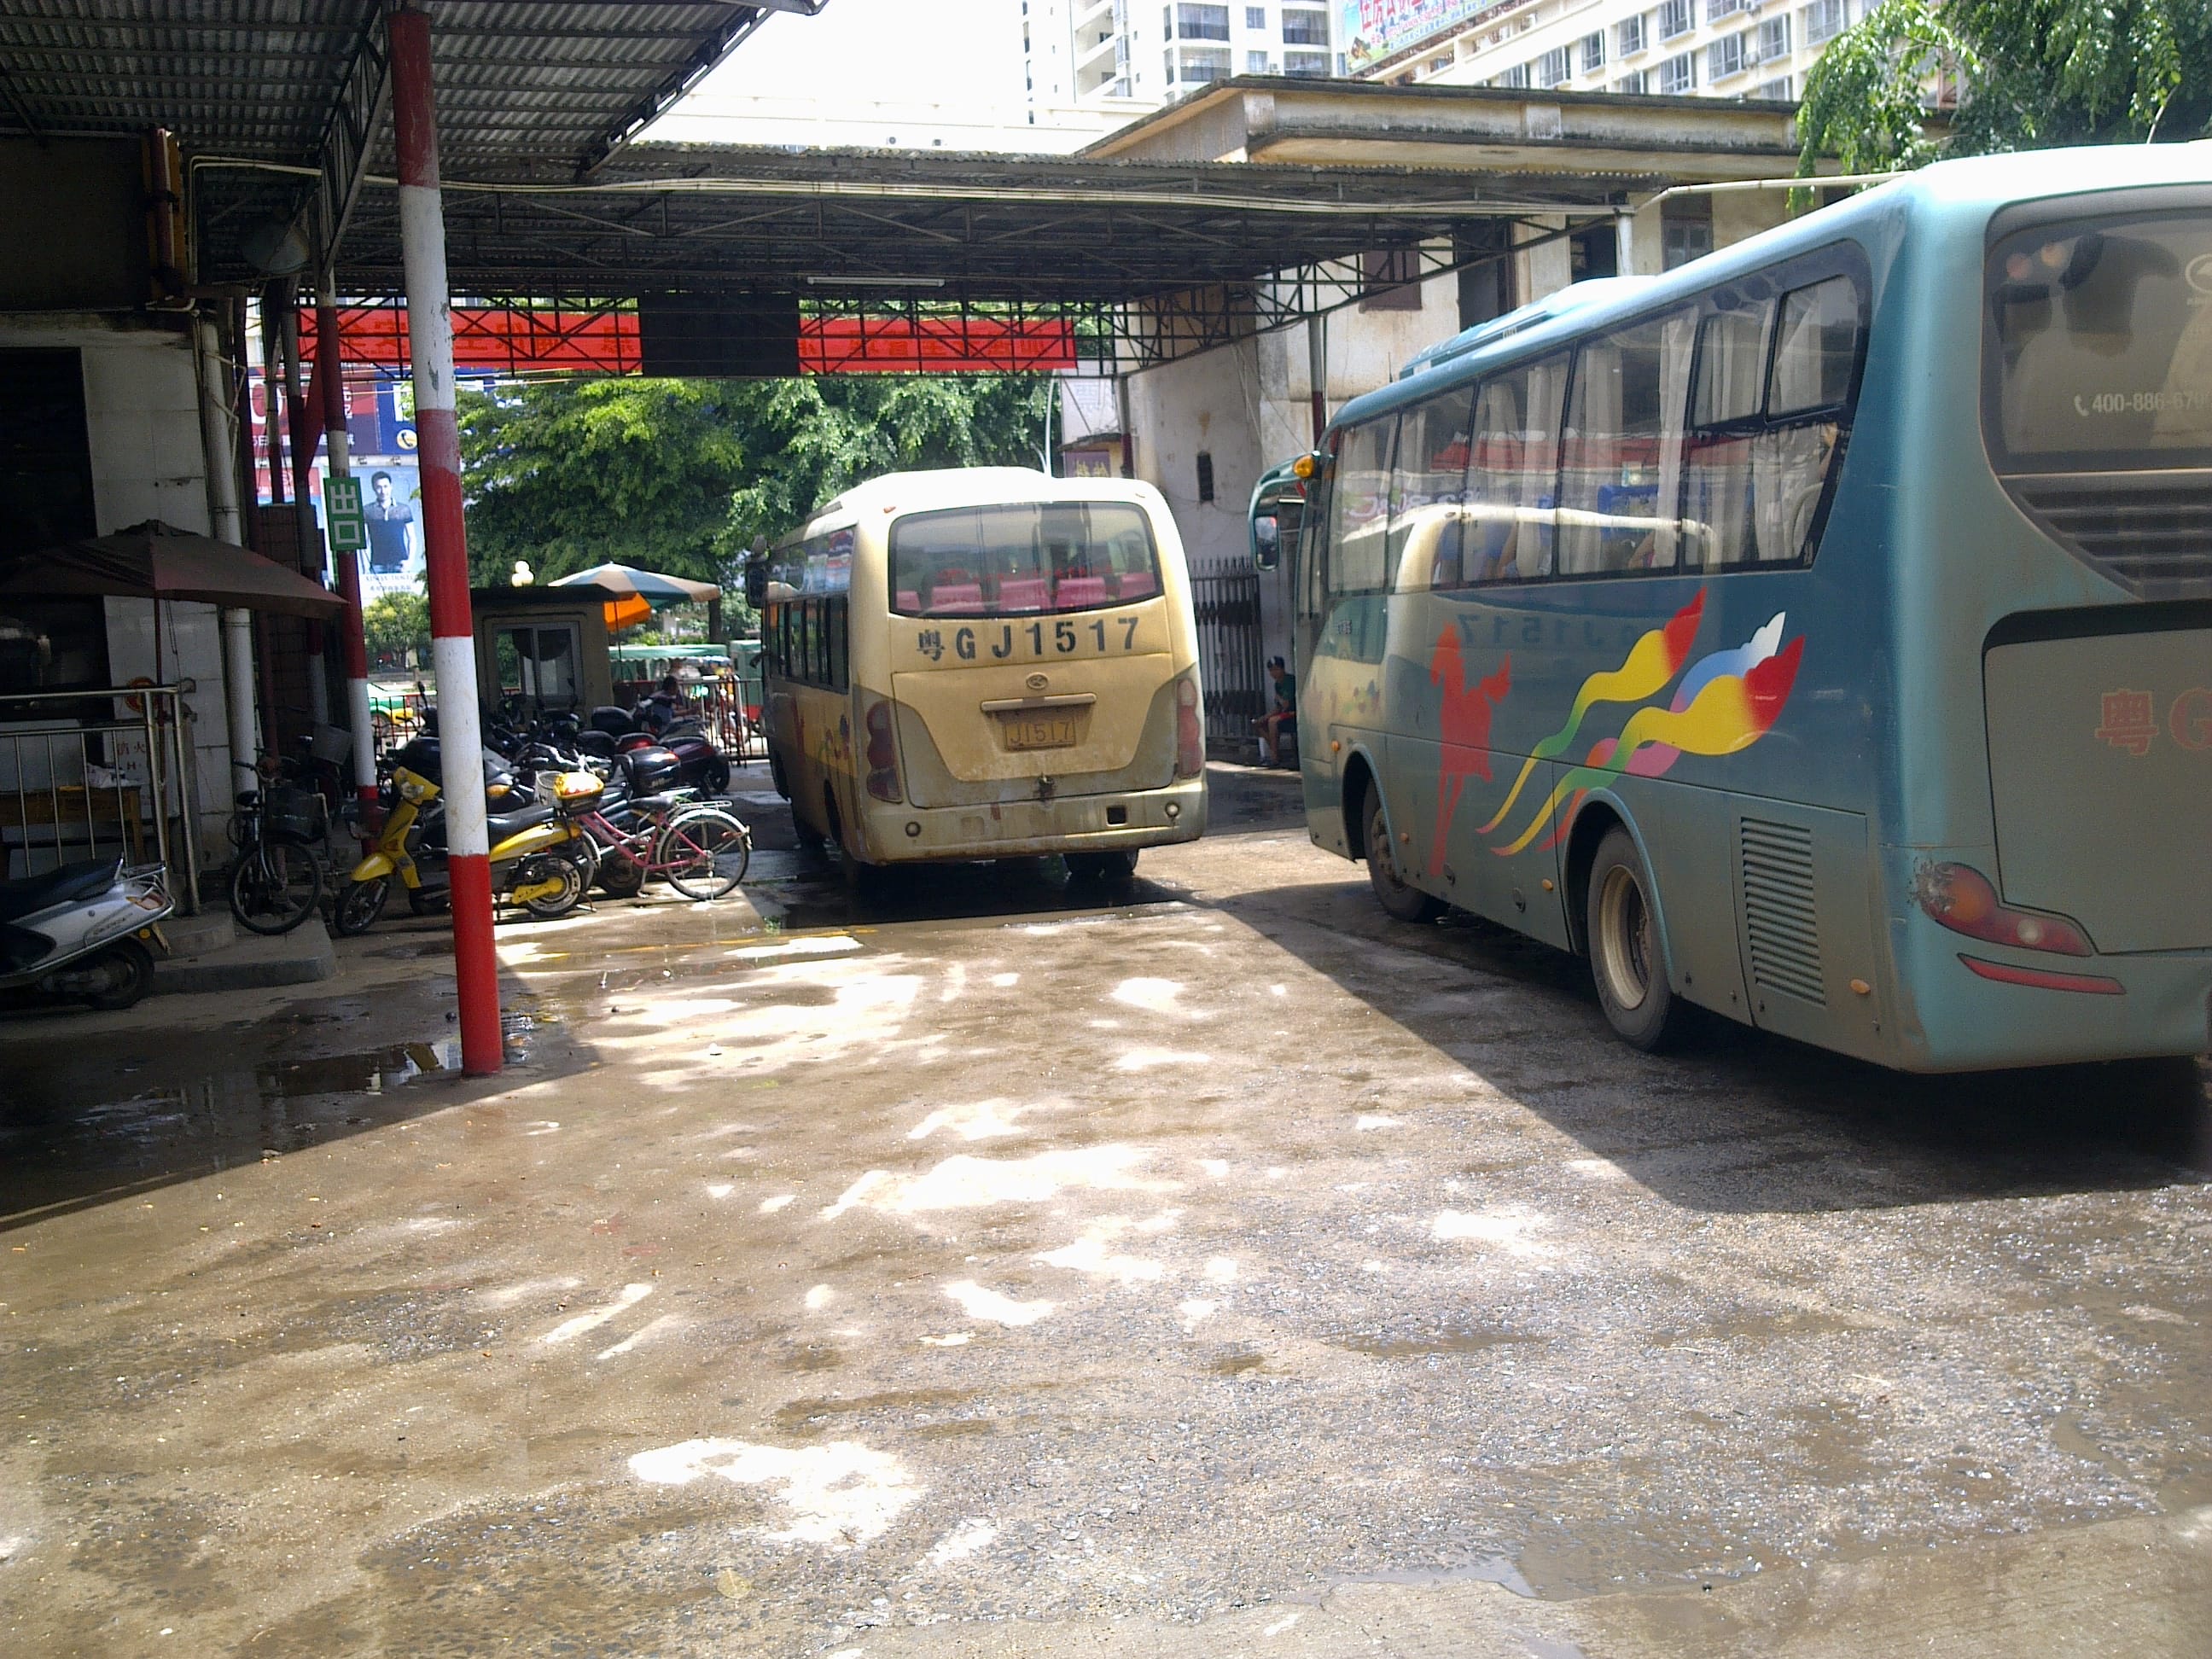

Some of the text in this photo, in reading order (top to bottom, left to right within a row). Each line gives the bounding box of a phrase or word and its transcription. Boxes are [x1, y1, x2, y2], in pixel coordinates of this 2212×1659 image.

[329, 483, 361, 544] 出口
[916, 616, 1139, 661] 粤GJ1517
[1010, 720, 1070, 744] J1517
